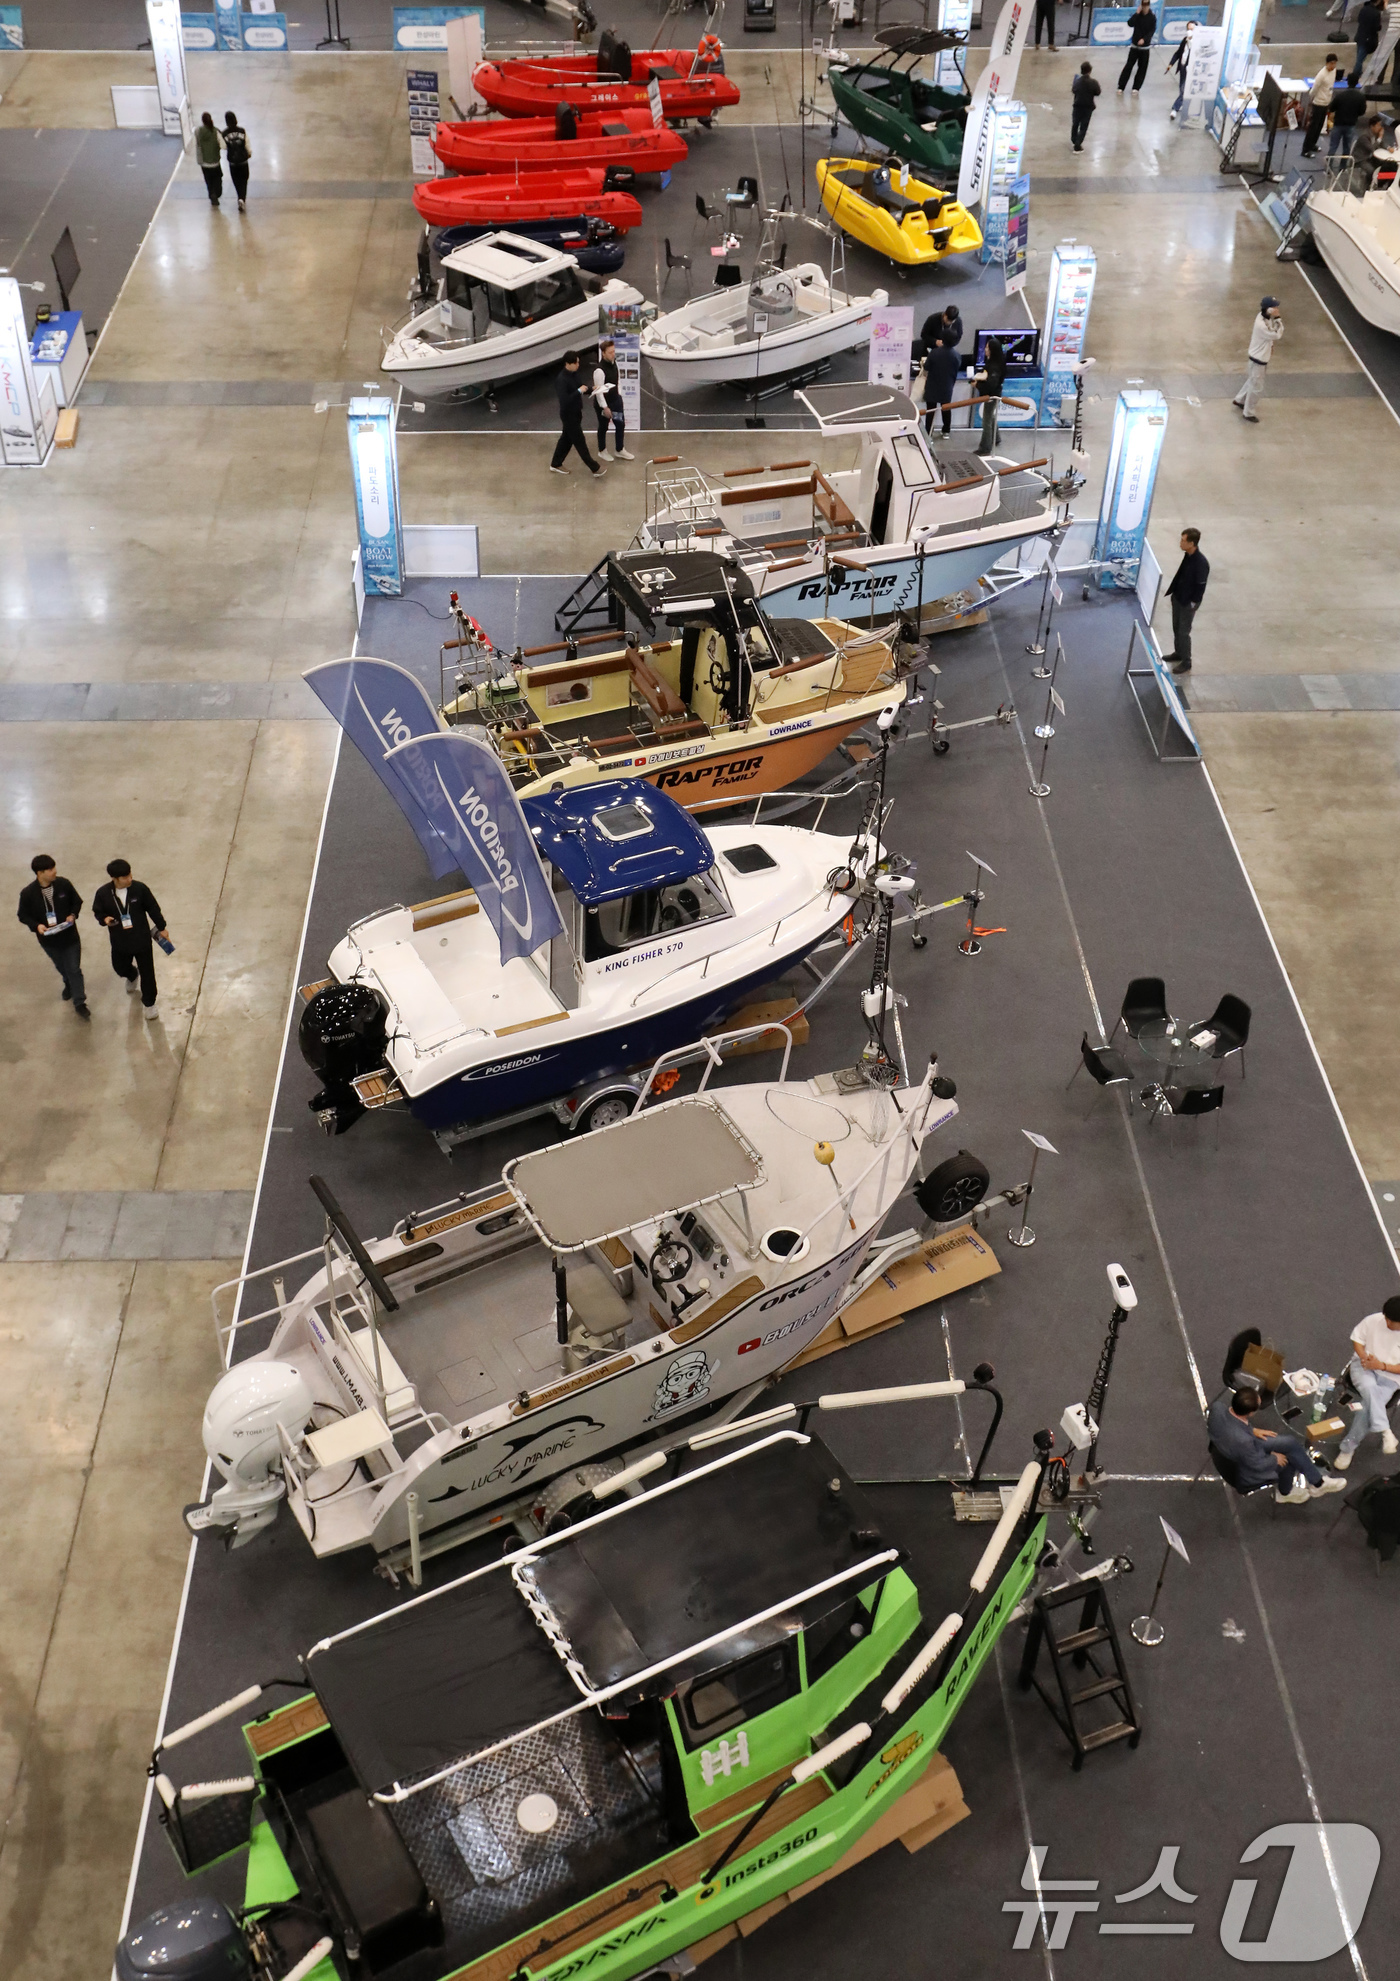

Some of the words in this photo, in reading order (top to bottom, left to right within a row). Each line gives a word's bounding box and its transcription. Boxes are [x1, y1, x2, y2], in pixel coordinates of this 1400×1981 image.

[368, 466, 380, 505] 파도소리
[365, 547, 392, 555] BOAT
[798, 575, 898, 601] RAPTOR
[849, 588, 894, 601] FAMILY
[769, 719, 813, 736] LOWRANCE
[655, 756, 764, 790] RAPTOR
[712, 770, 758, 787] FAMILY
[605, 958, 630, 973] KING
[632, 948, 663, 965] FISHER
[667, 941, 684, 954] 570
[331, 1032, 356, 1041] TOHATSU
[485, 1054, 541, 1076] POSEIDON
[929, 1110, 954, 1132] LOWRANCE
[433, 1216, 461, 1231] LUCKY
[462, 1203, 494, 1219] MARINE
[759, 1270, 832, 1312] ORCA
[308, 1317, 326, 1346] LOWRANCE
[470, 1461, 519, 1491] LUCKY
[524, 1435, 576, 1467] MARINE
[724, 1826, 818, 1889] Insta360
